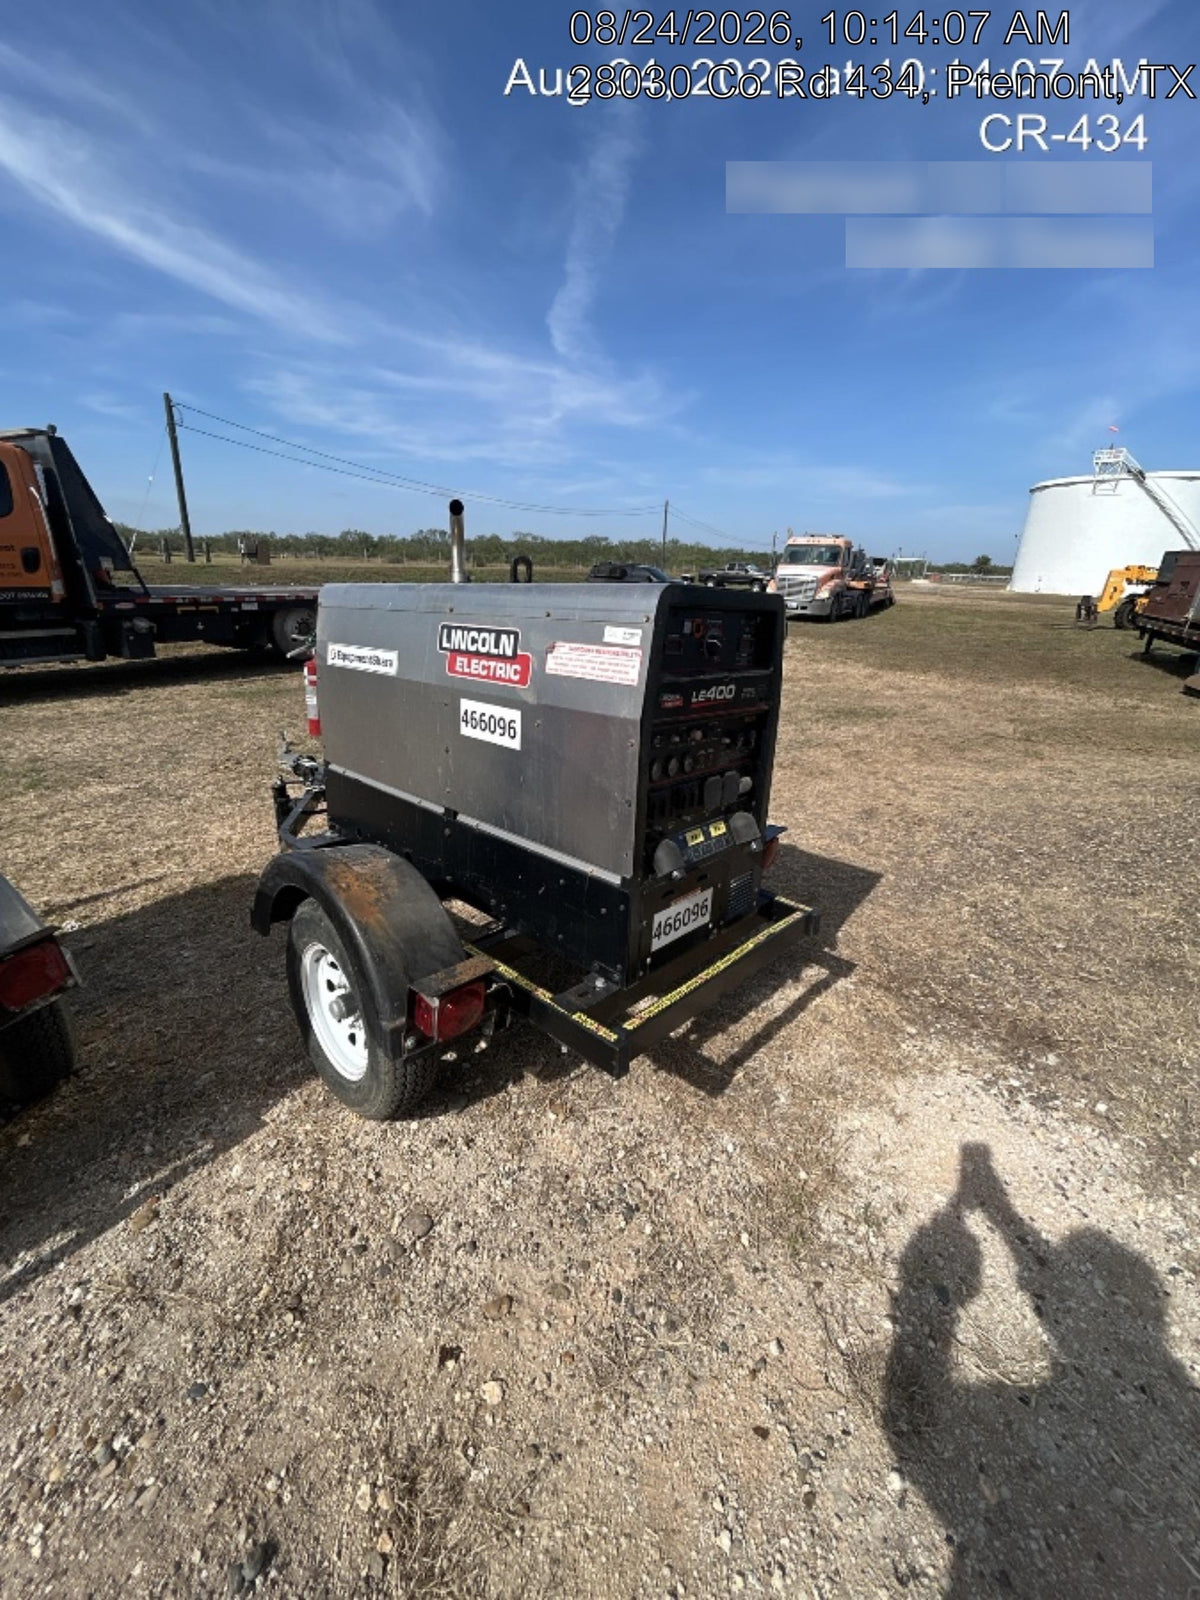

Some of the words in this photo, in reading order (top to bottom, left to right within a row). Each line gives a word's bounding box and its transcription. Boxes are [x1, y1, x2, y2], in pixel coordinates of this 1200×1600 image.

[442, 628, 515, 657] LINCOLN
[455, 656, 522, 682] ELECTRIC
[691, 684, 737, 704] LE400
[460, 708, 518, 740] 466096
[652, 897, 709, 941] 466096
